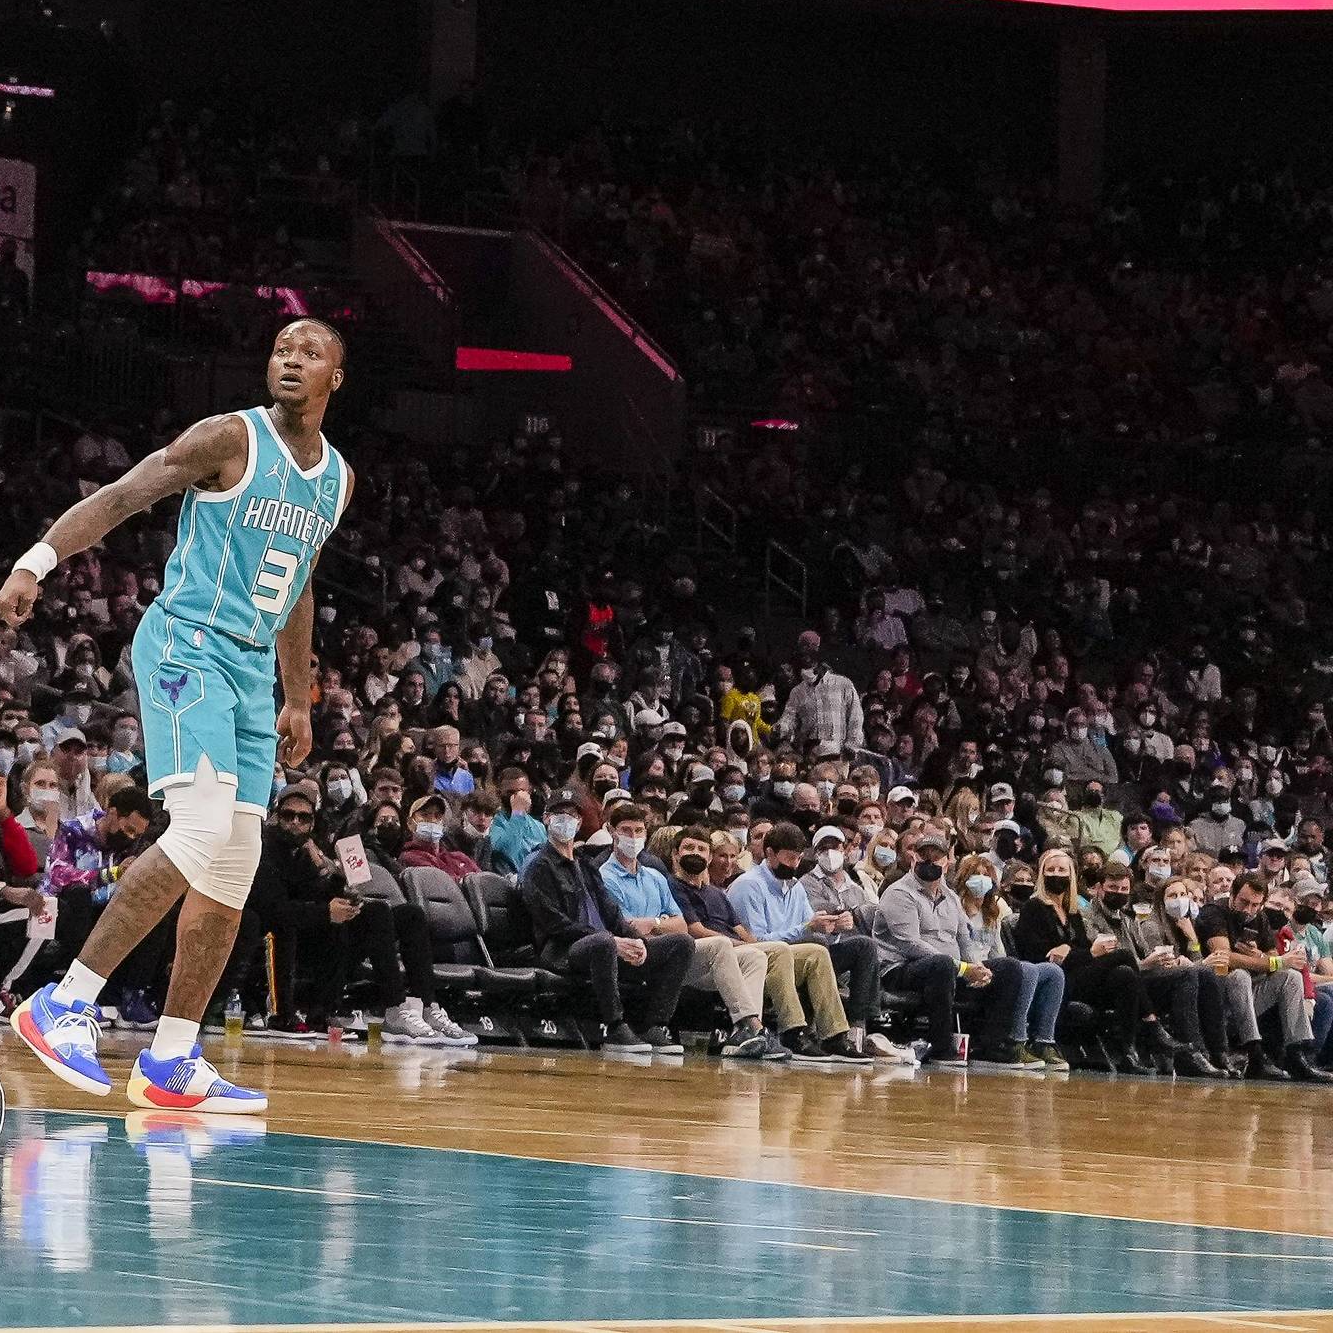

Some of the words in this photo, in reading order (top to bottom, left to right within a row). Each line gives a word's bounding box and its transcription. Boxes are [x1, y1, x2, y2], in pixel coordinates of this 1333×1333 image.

[242, 496, 332, 551] HORNETS
[251, 547, 299, 616] 3
[541, 1019, 557, 1035] 20
